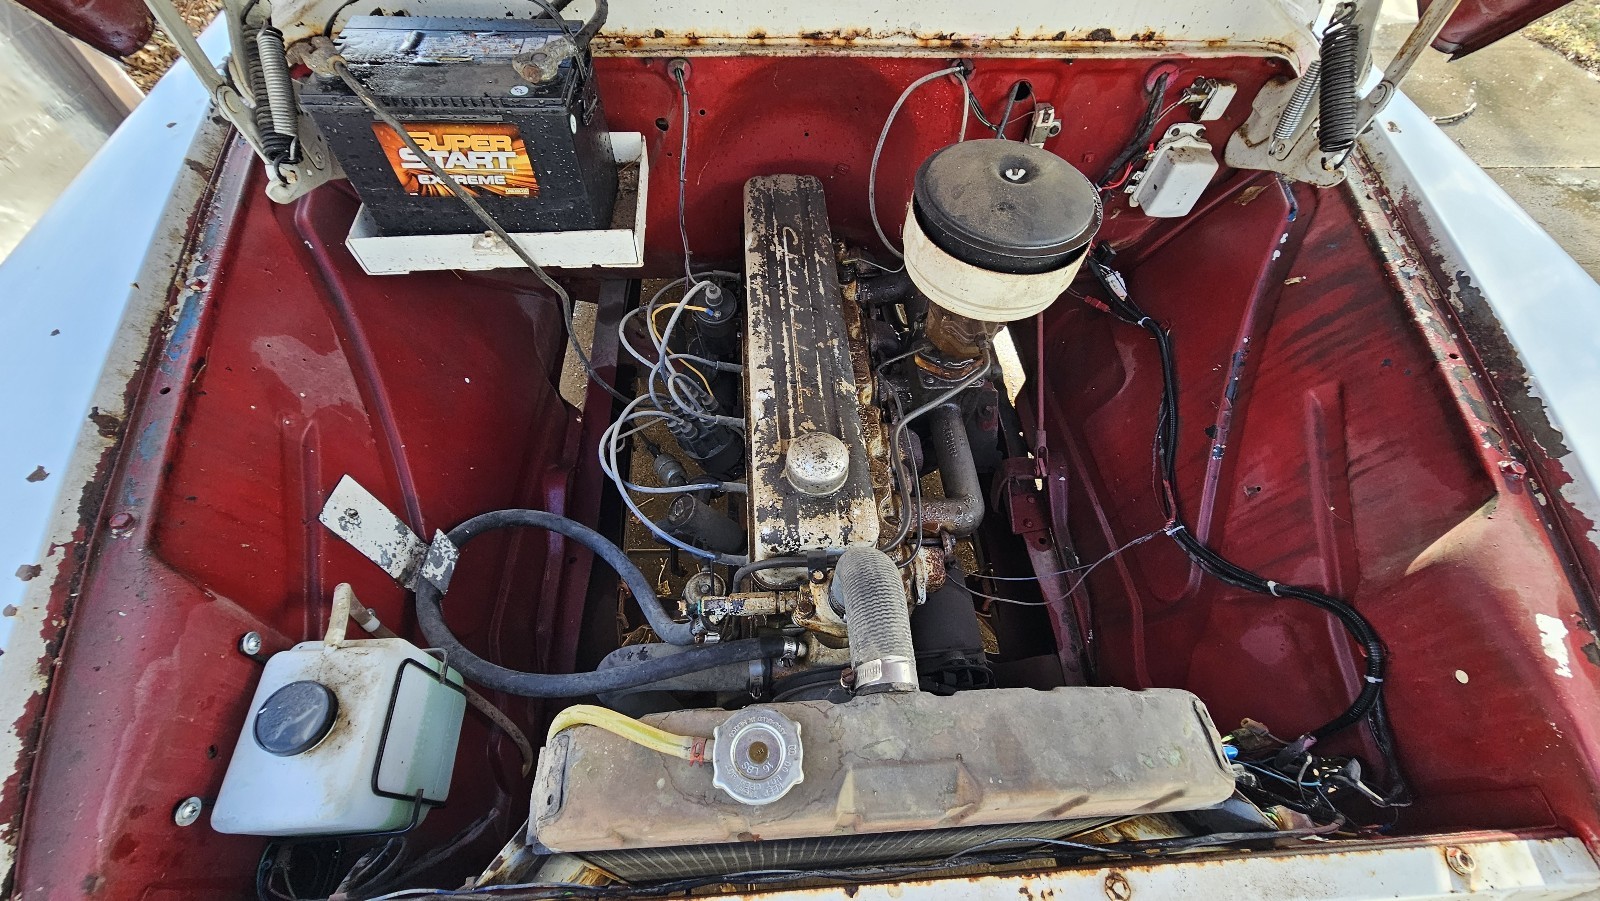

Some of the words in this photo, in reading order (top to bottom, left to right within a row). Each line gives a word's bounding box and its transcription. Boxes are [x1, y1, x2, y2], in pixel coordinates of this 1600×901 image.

[406, 132, 513, 152] SUPER
[399, 147, 518, 169] START
[417, 174, 506, 185] EXREME
[741, 761, 759, 775] LBS
[762, 762, 774, 773] 16
